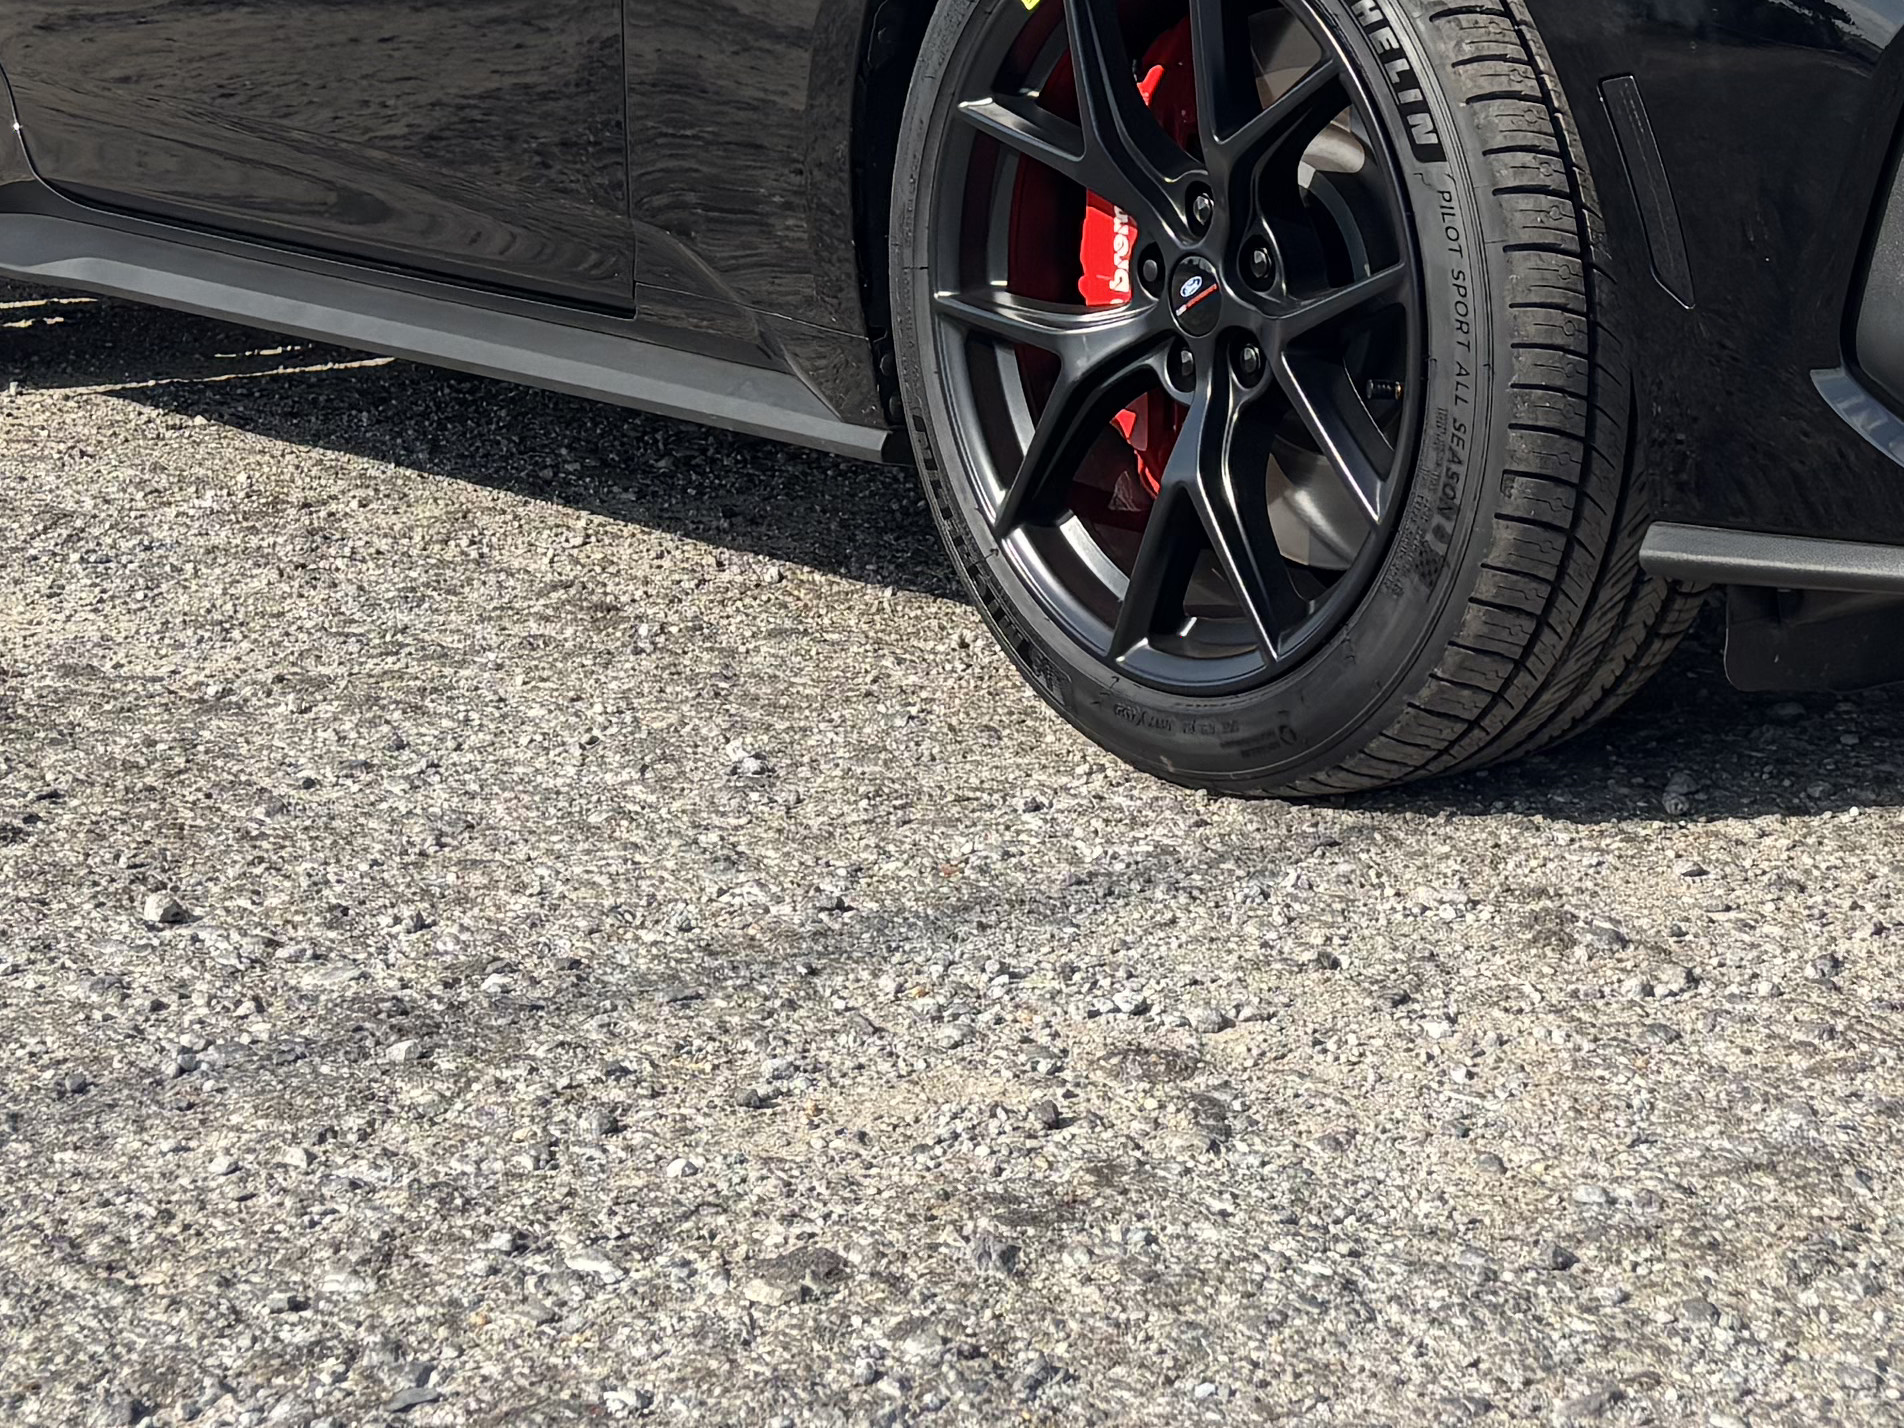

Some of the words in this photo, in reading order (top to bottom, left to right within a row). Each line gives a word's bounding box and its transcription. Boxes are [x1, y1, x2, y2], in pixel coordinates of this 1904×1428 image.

[1109, 205, 1130, 293] brem
[1437, 189, 1463, 259] PILOT
[1451, 270, 1471, 352] SPORT
[1454, 360, 1470, 407] ALL
[1438, 421, 1467, 514] SEASON
